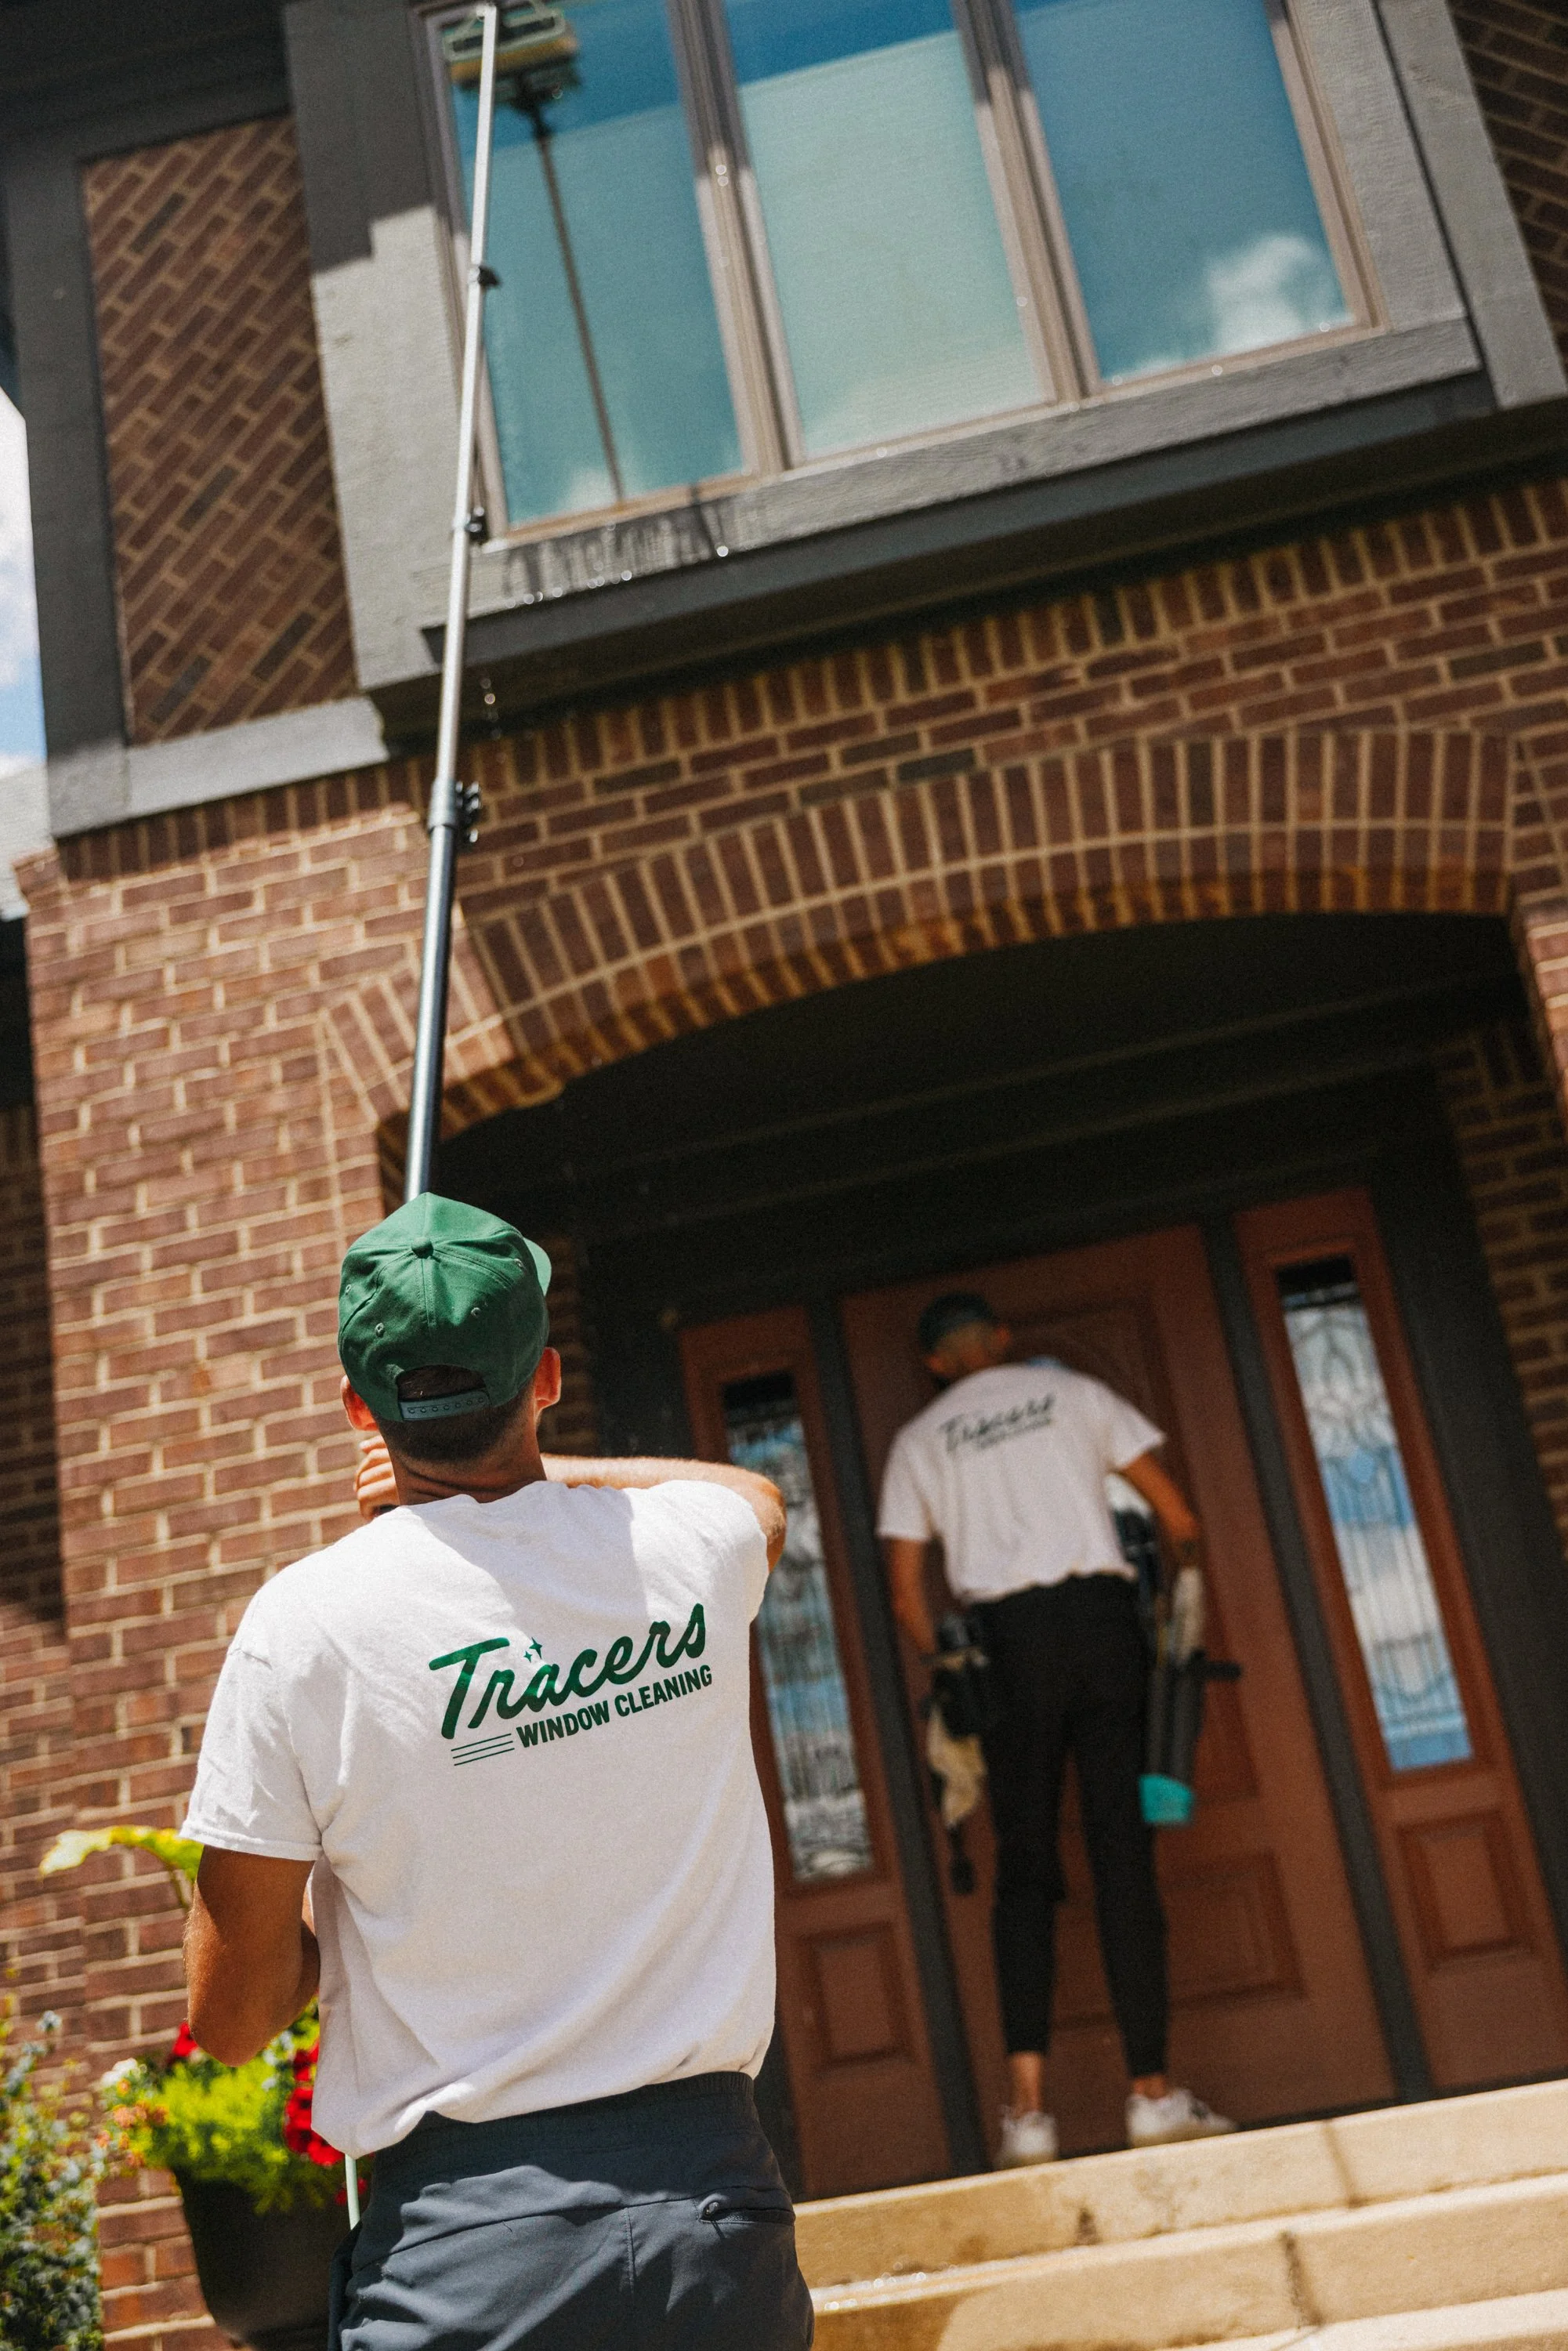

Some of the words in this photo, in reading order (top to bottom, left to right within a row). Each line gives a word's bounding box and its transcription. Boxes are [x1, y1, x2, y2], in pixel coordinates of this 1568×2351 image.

[429, 1603, 706, 1741] Tracers
[516, 1700, 610, 1748] WINDOW
[614, 1665, 713, 1718] CLEANING
